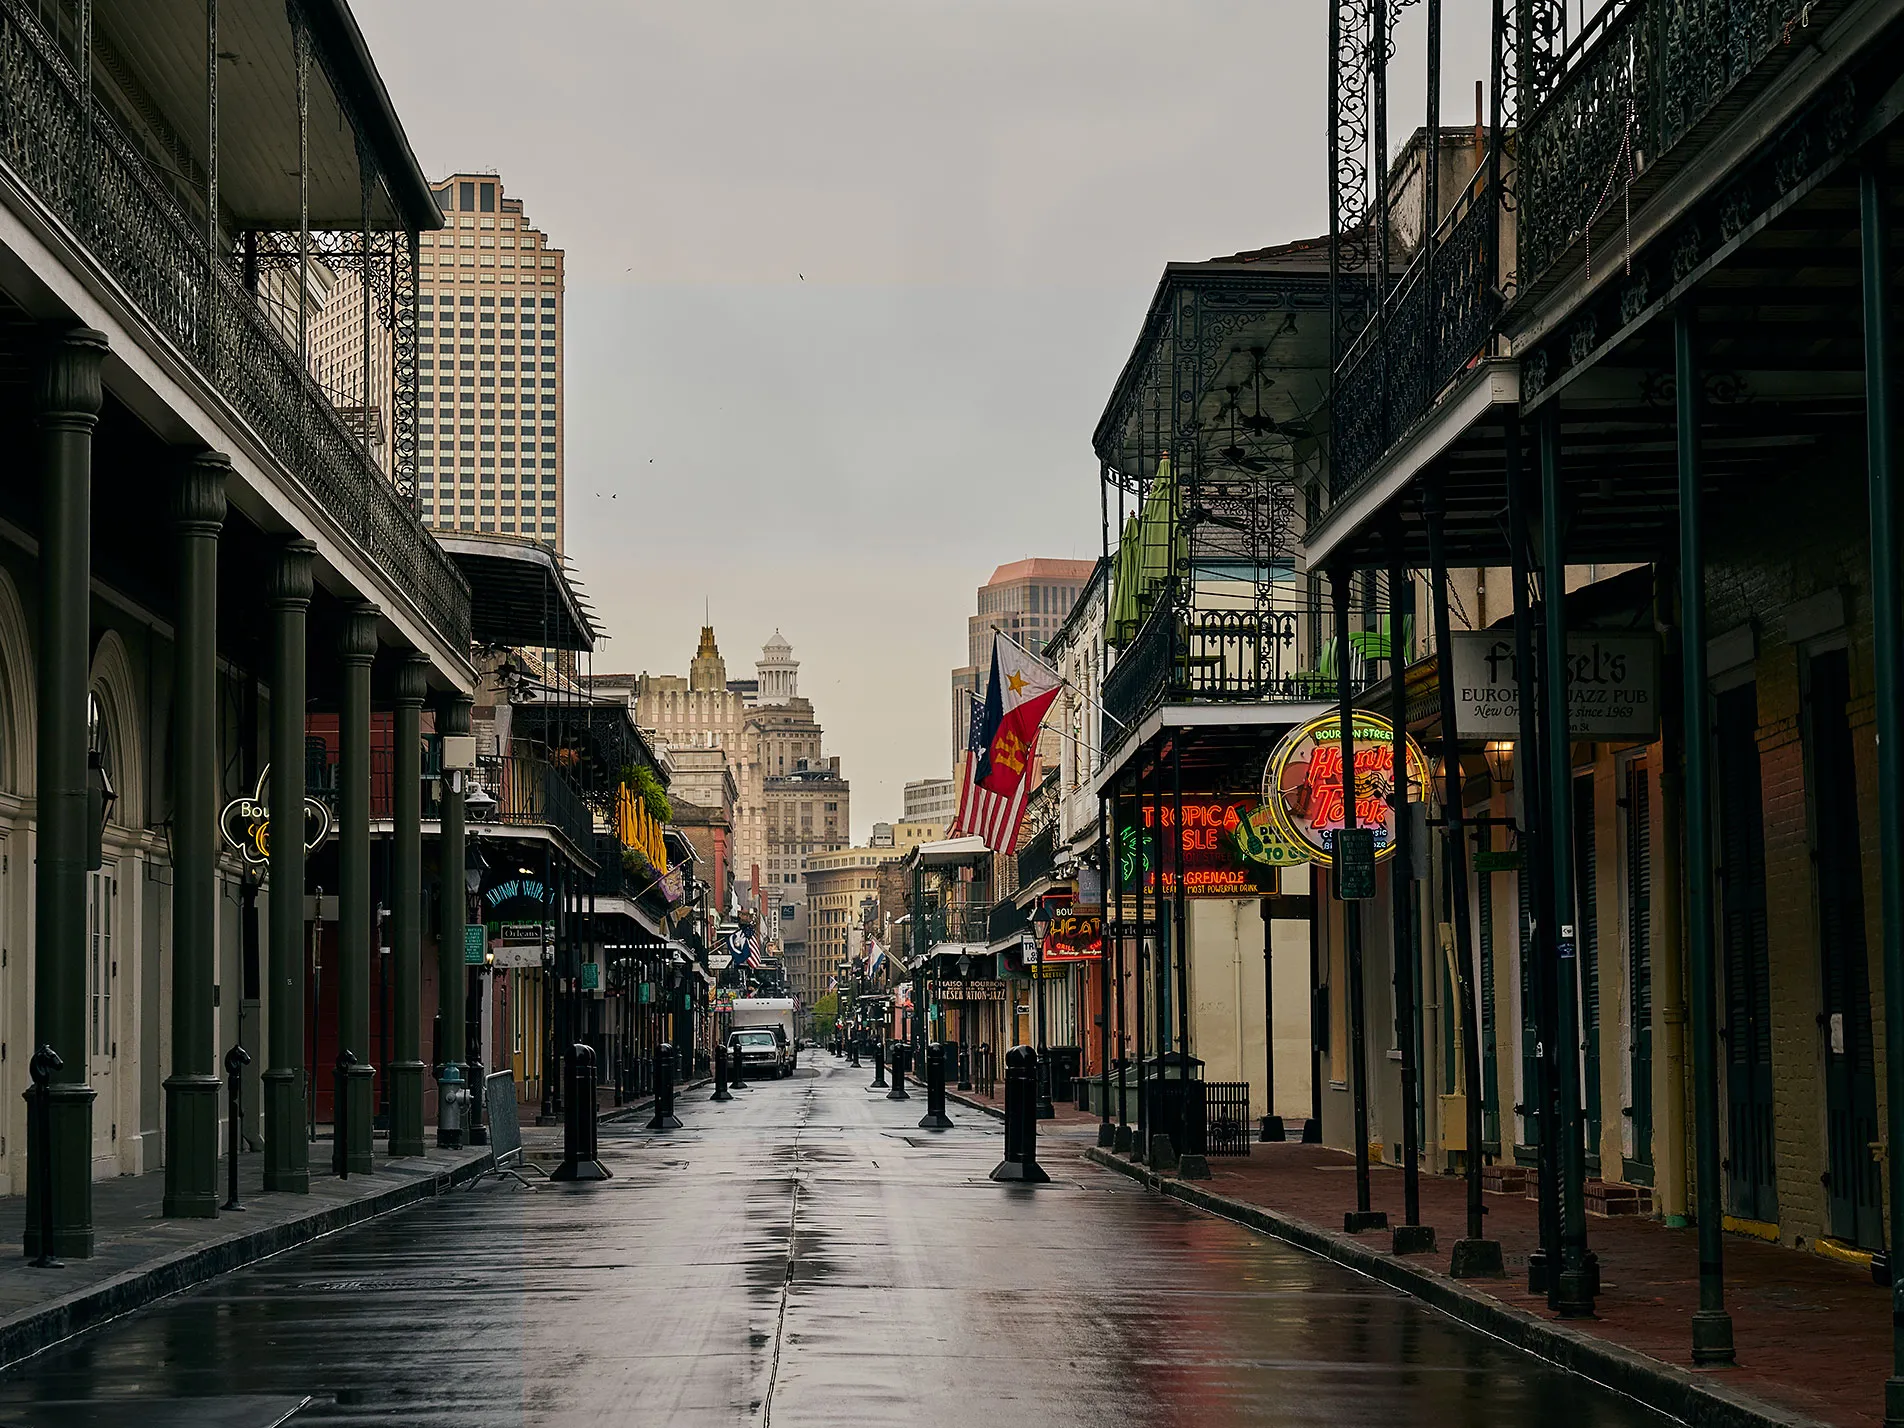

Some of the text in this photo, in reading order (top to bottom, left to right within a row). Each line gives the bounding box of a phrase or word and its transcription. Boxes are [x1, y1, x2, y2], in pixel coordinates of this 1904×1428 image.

[1567, 690, 1608, 702] JAZZ
[1614, 690, 1648, 703] PUB
[1474, 704, 1502, 718] New
[1575, 705, 1602, 718] since
[1605, 706, 1634, 718] 1969
[1315, 728, 1394, 741] BOURN STREET
[1308, 745, 1411, 787] Hnk
[241, 801, 311, 818] Boun
[1312, 784, 1389, 829] Tonk
[1142, 805, 1240, 827] TROPICA
[1181, 829, 1218, 850] SLE
[1265, 848, 1283, 860] TO
[1188, 885, 1205, 894] MOST
[1208, 885, 1239, 894] POWERFUL
[1239, 884, 1258, 893] DRINK
[504, 929, 539, 938] Orleans
[1050, 918, 1101, 938] HEAT
[1056, 940, 1102, 951] GRILL CLU
